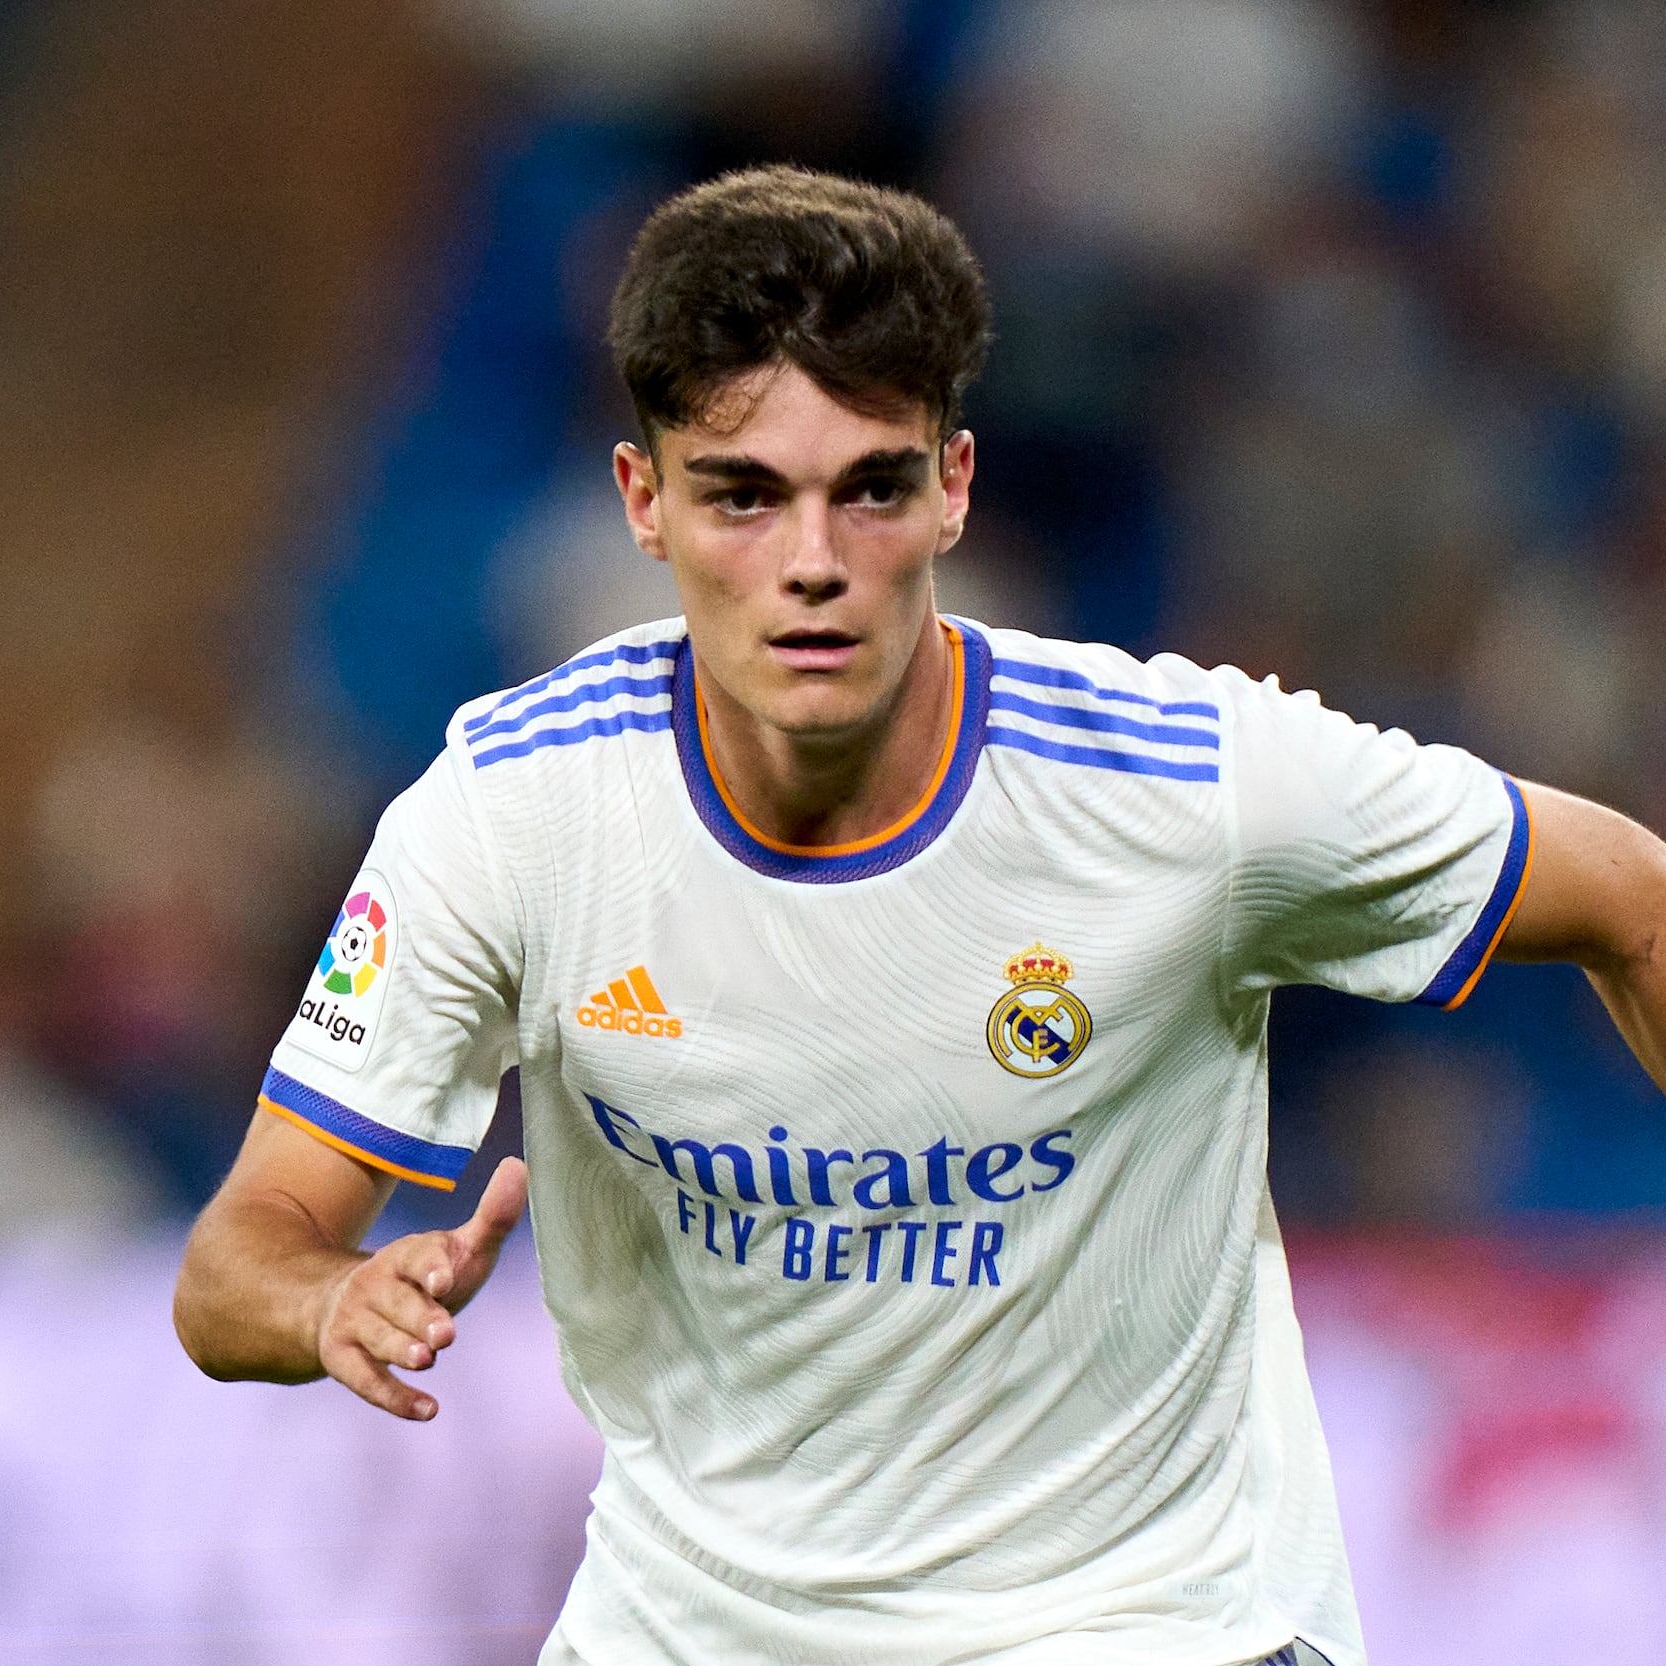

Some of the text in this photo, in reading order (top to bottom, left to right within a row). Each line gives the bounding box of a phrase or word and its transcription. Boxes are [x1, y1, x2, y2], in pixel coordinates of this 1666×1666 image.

[299, 999, 366, 1046] aLiga
[576, 1006, 683, 1039] adidas
[583, 1091, 1076, 1211] Emirates
[677, 1187, 1004, 1288] FLY BETTER
